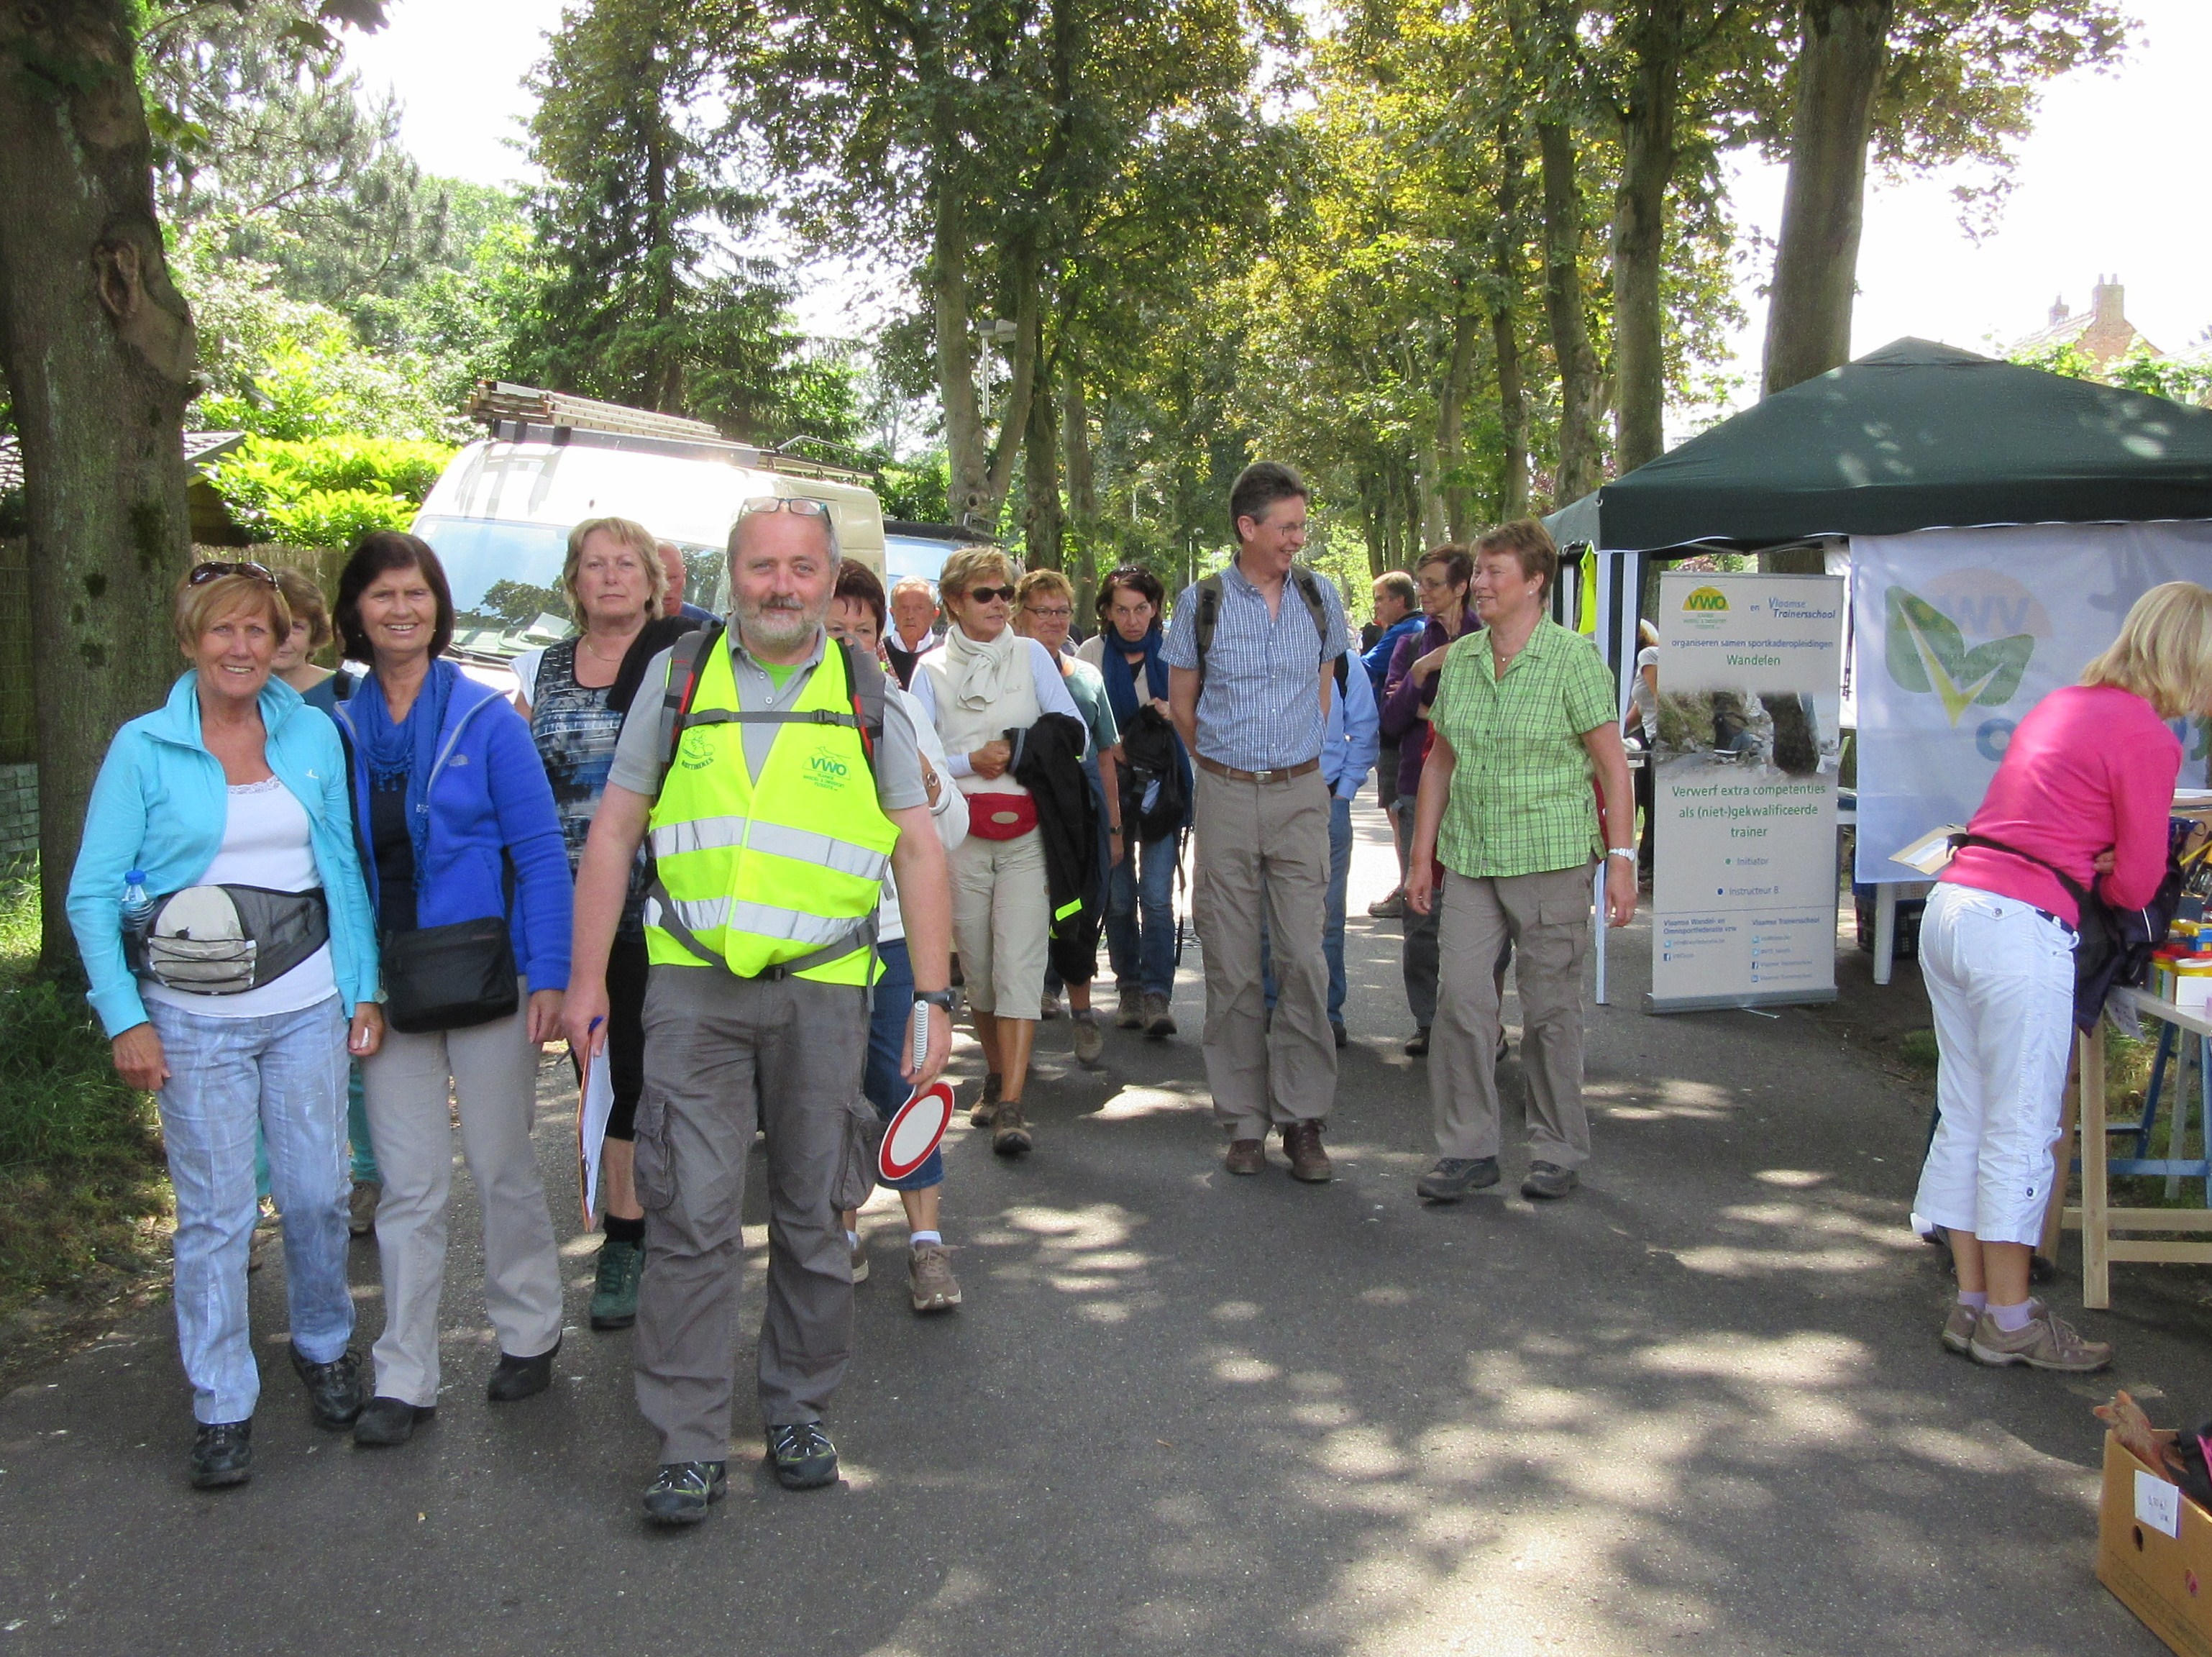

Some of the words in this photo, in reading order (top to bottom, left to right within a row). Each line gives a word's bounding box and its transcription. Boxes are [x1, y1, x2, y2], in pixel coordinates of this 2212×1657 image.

[1688, 595, 1727, 610] VWO
[1768, 597, 1806, 609] Vlaamse
[1773, 608, 1836, 618] Trainersschool
[1671, 637, 1719, 649] organiseren
[1748, 639, 1833, 650] sportkaderopleidingen
[1727, 653, 1781, 666] Wandelen
[810, 757, 847, 776] VWO
[1672, 785, 1718, 797] Verwerf
[1721, 786, 1750, 795] extra
[1752, 784, 1826, 798] competenties
[1679, 806, 1694, 818] als
[1698, 804, 1819, 820] (niet-)gekwalificeerde
[1730, 826, 1768, 837] trainer
